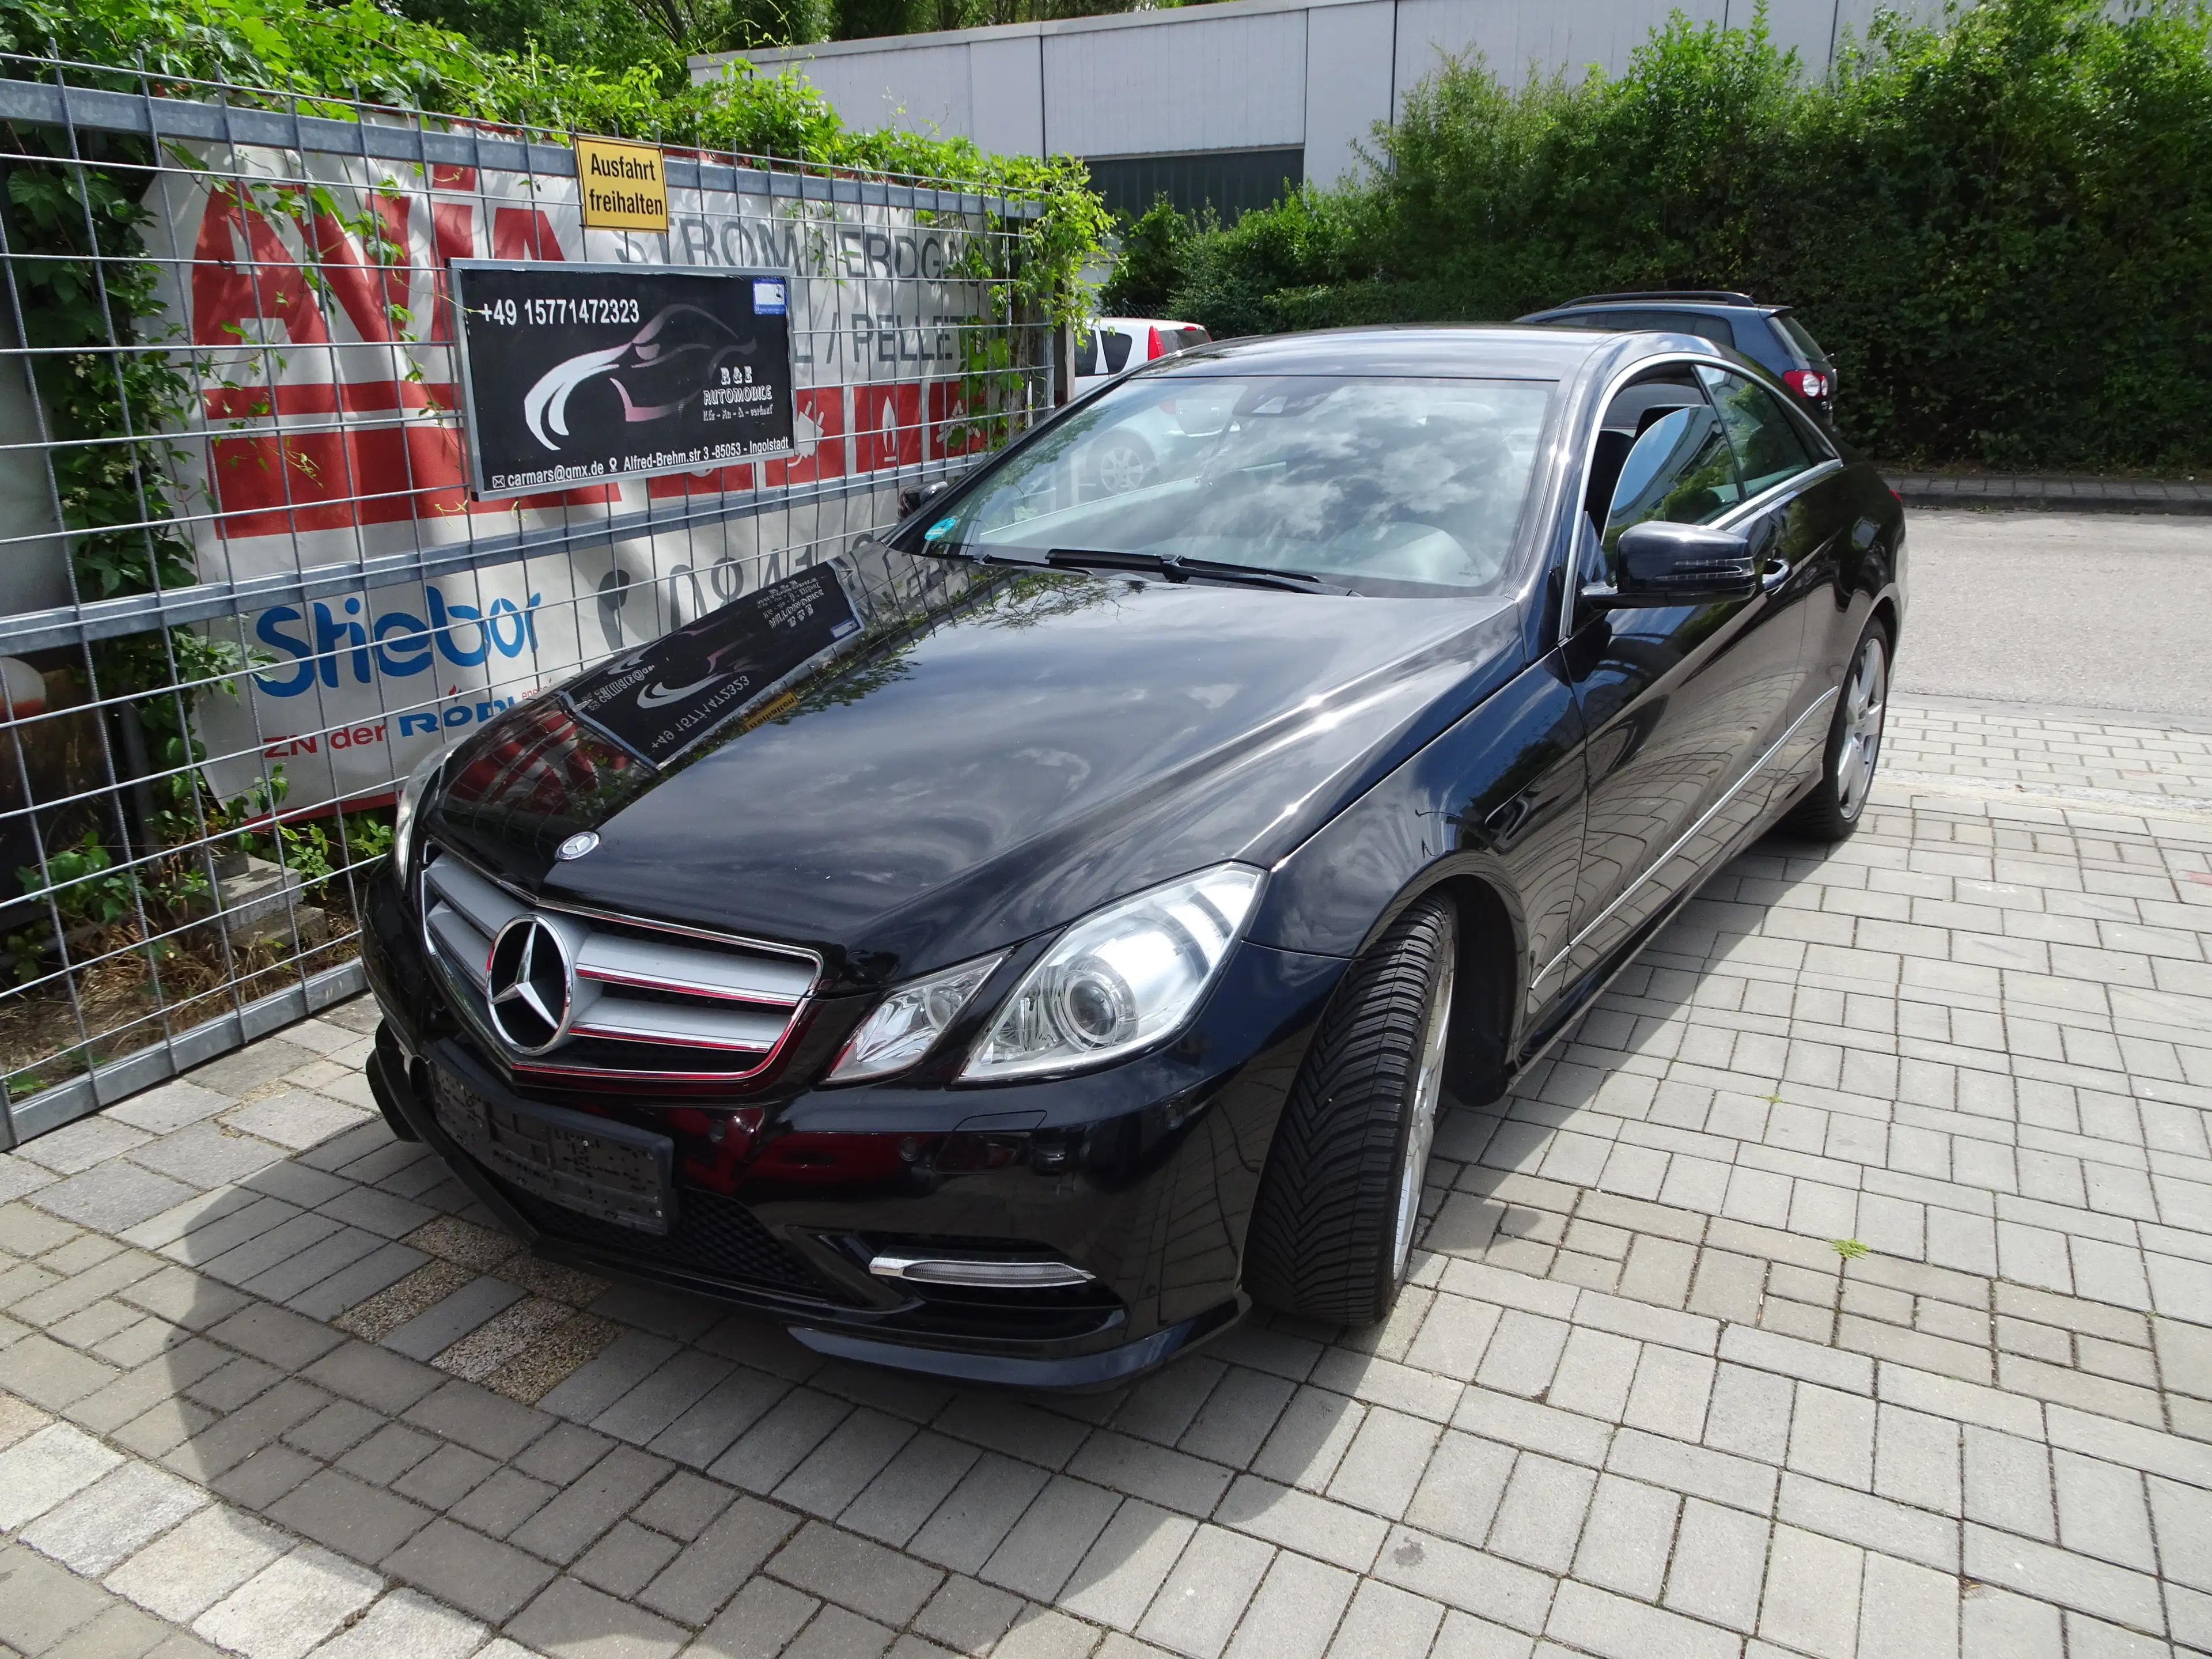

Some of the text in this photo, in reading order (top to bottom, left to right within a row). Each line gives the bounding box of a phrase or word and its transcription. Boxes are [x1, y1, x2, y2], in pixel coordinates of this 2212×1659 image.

[591, 153, 656, 181] Ausfahrt
[589, 188, 663, 215] freihalten
[482, 298, 639, 325] +49 15771472323
[720, 367, 731, 385] R
[733, 366, 743, 384] &
[703, 385, 773, 406] AUTOMOBILE
[508, 460, 604, 487] carmars@gmx.de
[623, 448, 701, 471] Alfred-Brehm.str
[703, 446, 709, 460] 3
[712, 442, 741, 459] -85053
[749, 436, 789, 455] Ingolstadt
[251, 586, 541, 697] Stiebor
[263, 734, 318, 759] ZN
[330, 725, 387, 750] der
